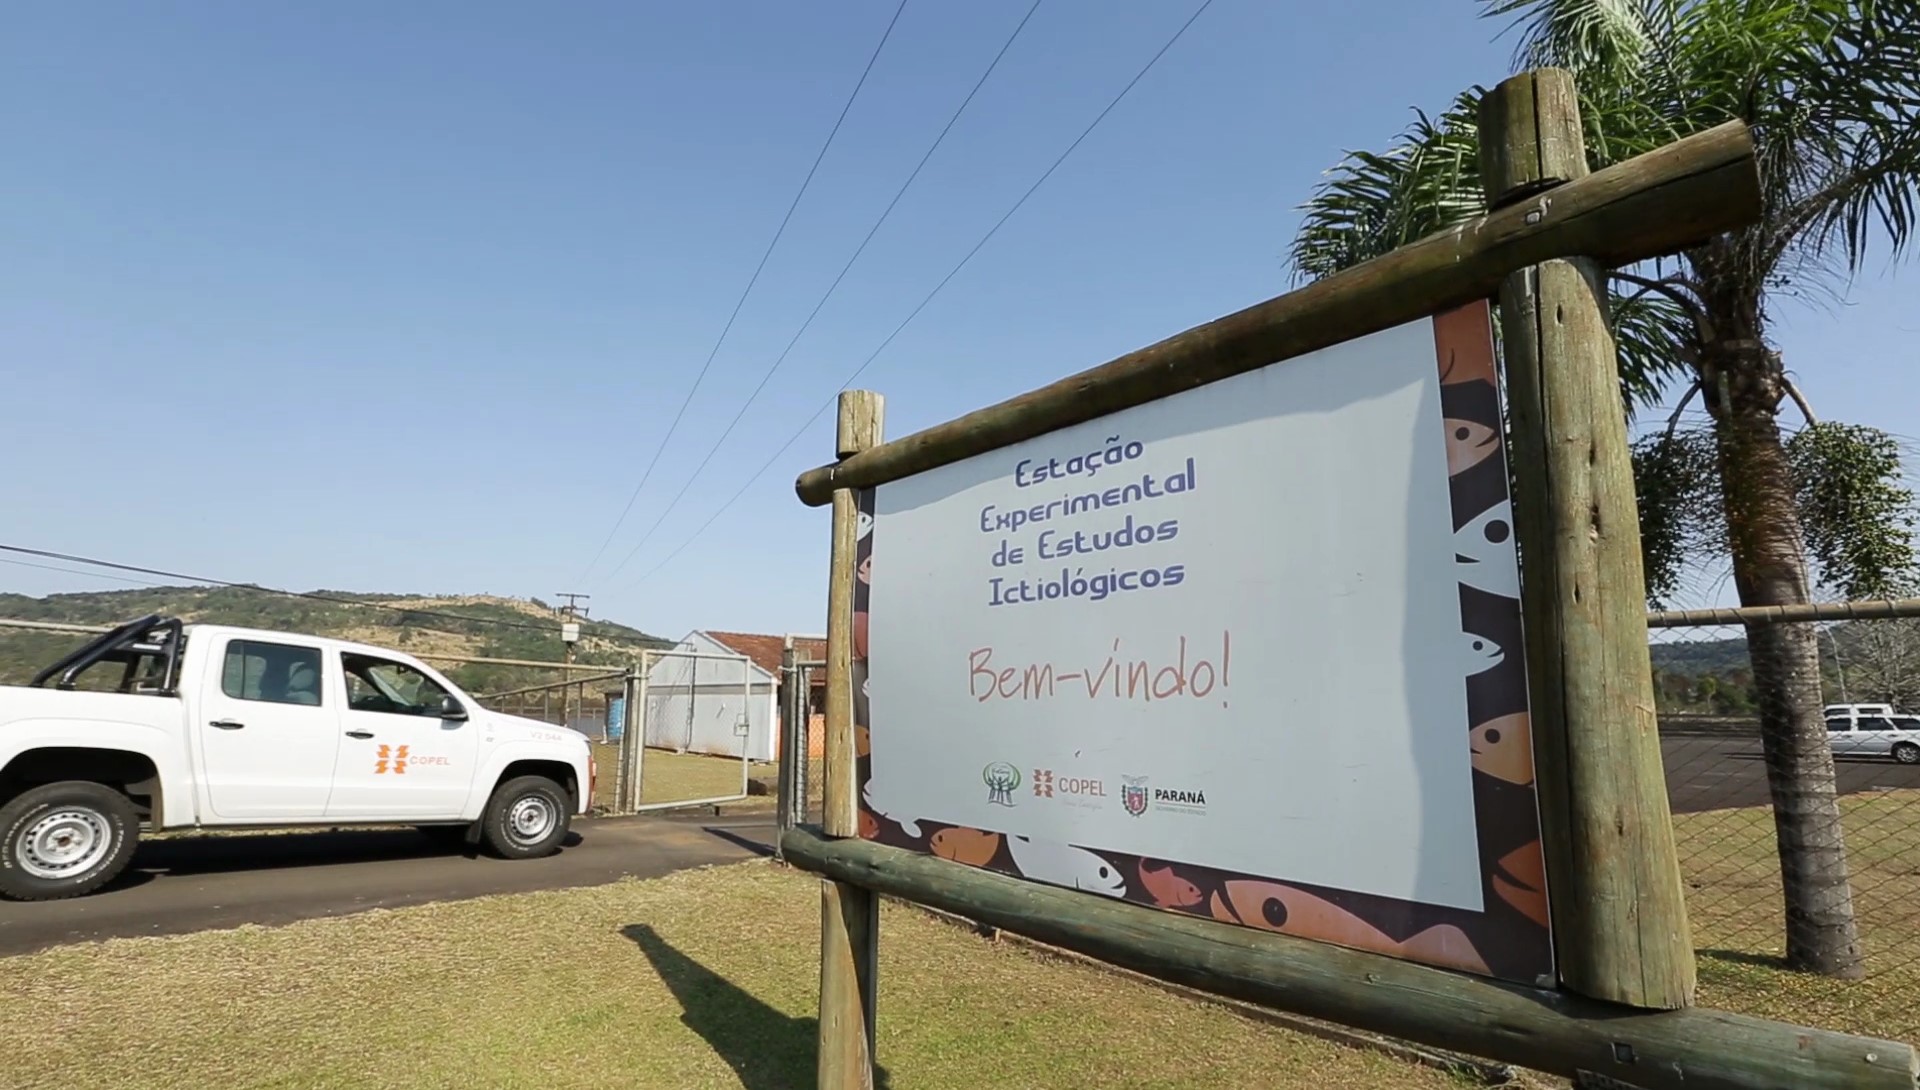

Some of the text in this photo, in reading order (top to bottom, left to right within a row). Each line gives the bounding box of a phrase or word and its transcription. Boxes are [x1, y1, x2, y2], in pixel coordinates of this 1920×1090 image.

[1015, 435, 1143, 488] Estação
[980, 457, 1196, 532] Experimental
[991, 515, 1178, 567] de Estudos
[988, 565, 1185, 606] Ictiológicos
[968, 630, 1230, 708] Bem-vindo!
[409, 755, 450, 766] COPEL
[1058, 777, 1107, 797] COPEL
[1154, 788, 1206, 805] PARANÁ
